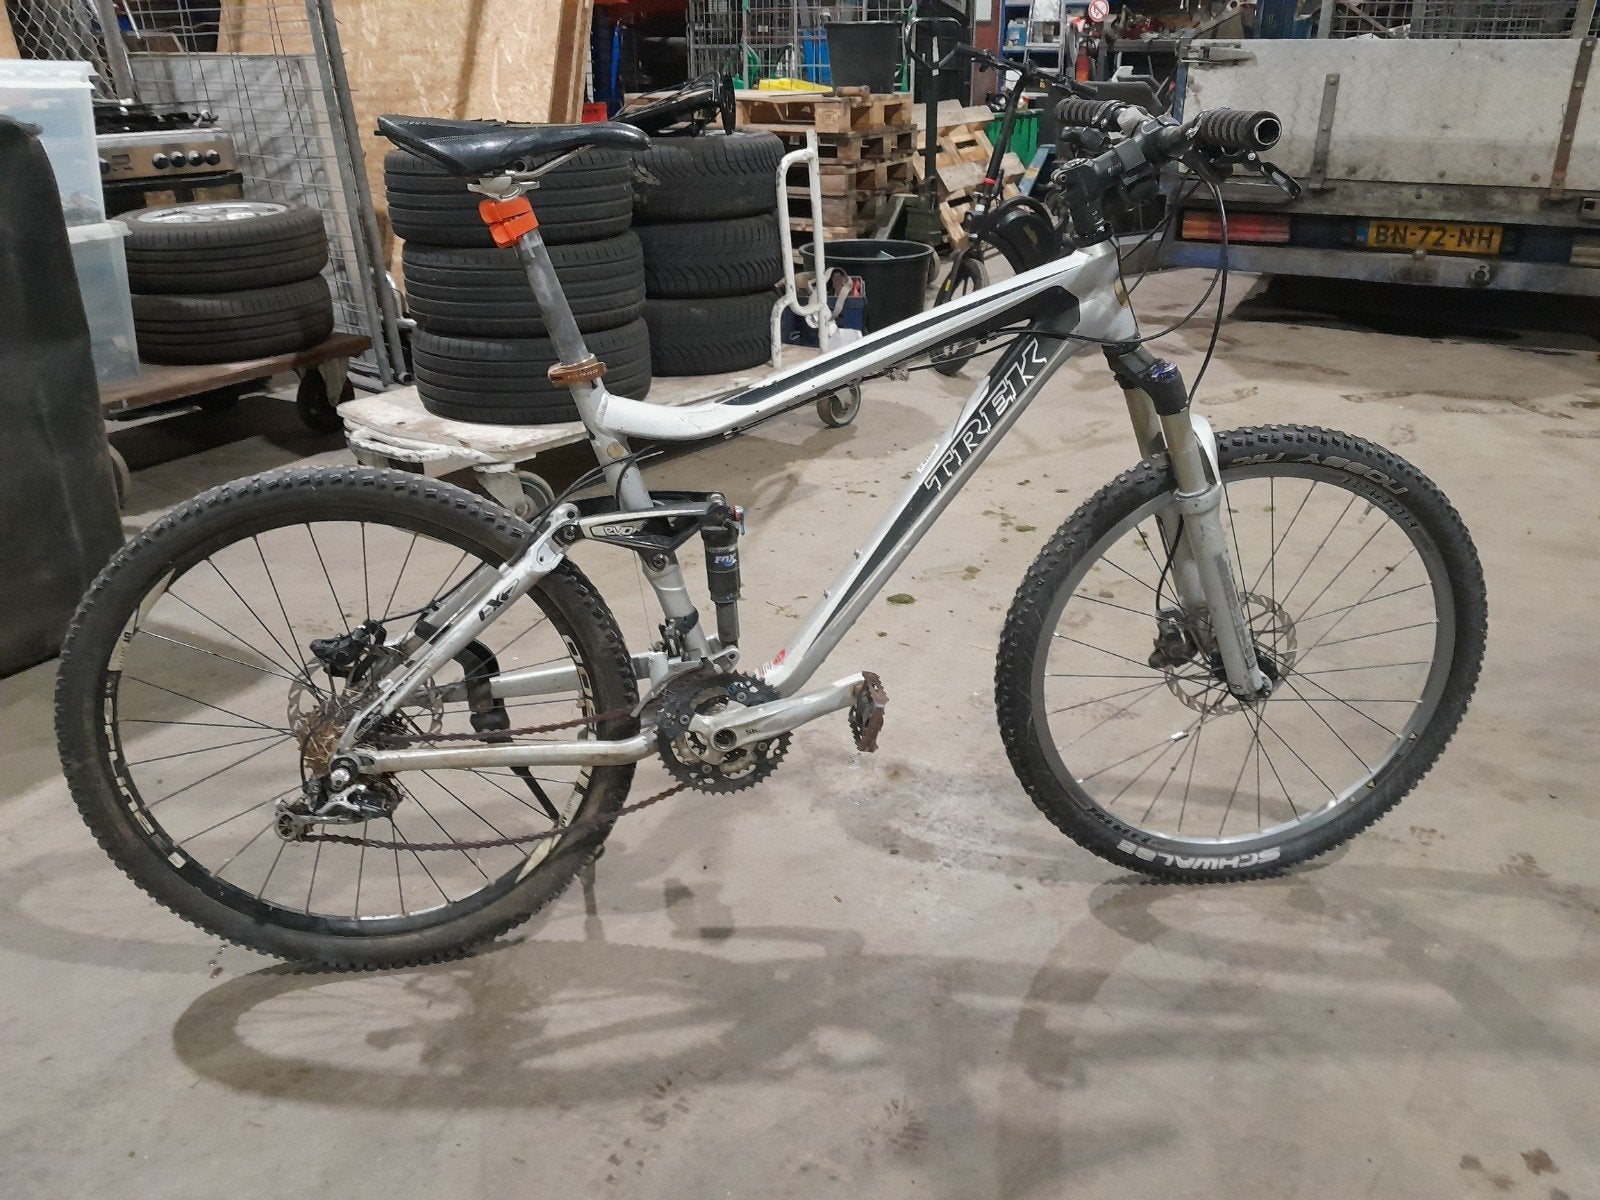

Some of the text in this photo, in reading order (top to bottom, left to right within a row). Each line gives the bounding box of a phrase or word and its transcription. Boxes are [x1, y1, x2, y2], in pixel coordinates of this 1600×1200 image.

[1374, 223, 1496, 250] BN-72-NH
[924, 338, 1048, 491] TREK
[714, 552, 738, 566] FOX
[1115, 838, 1281, 870] SCHWALBE
